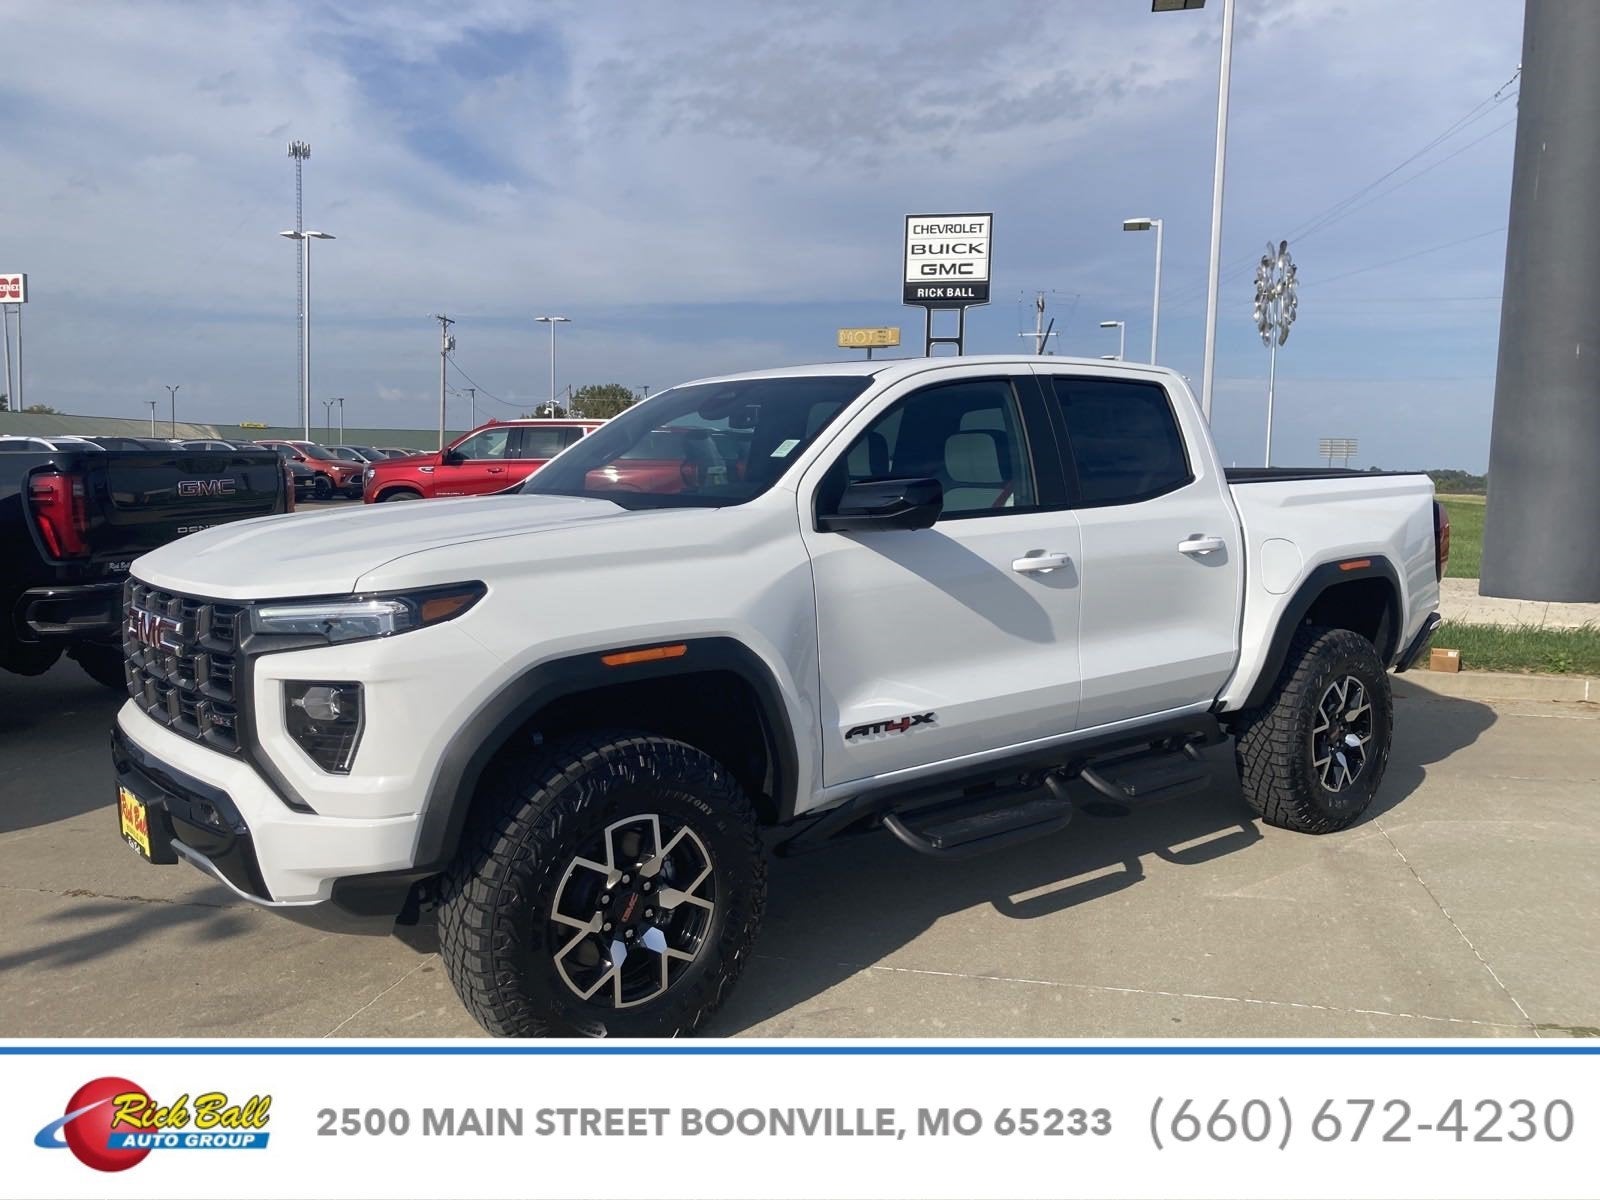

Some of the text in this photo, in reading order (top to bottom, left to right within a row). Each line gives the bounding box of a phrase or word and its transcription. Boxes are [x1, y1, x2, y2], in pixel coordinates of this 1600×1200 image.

[913, 223, 984, 235] CHEVROLET
[911, 243, 984, 255] BUICK
[920, 263, 974, 275] GMC
[917, 287, 975, 298] RICK BALL
[177, 479, 236, 496] GMC
[845, 712, 935, 740] AT4X
